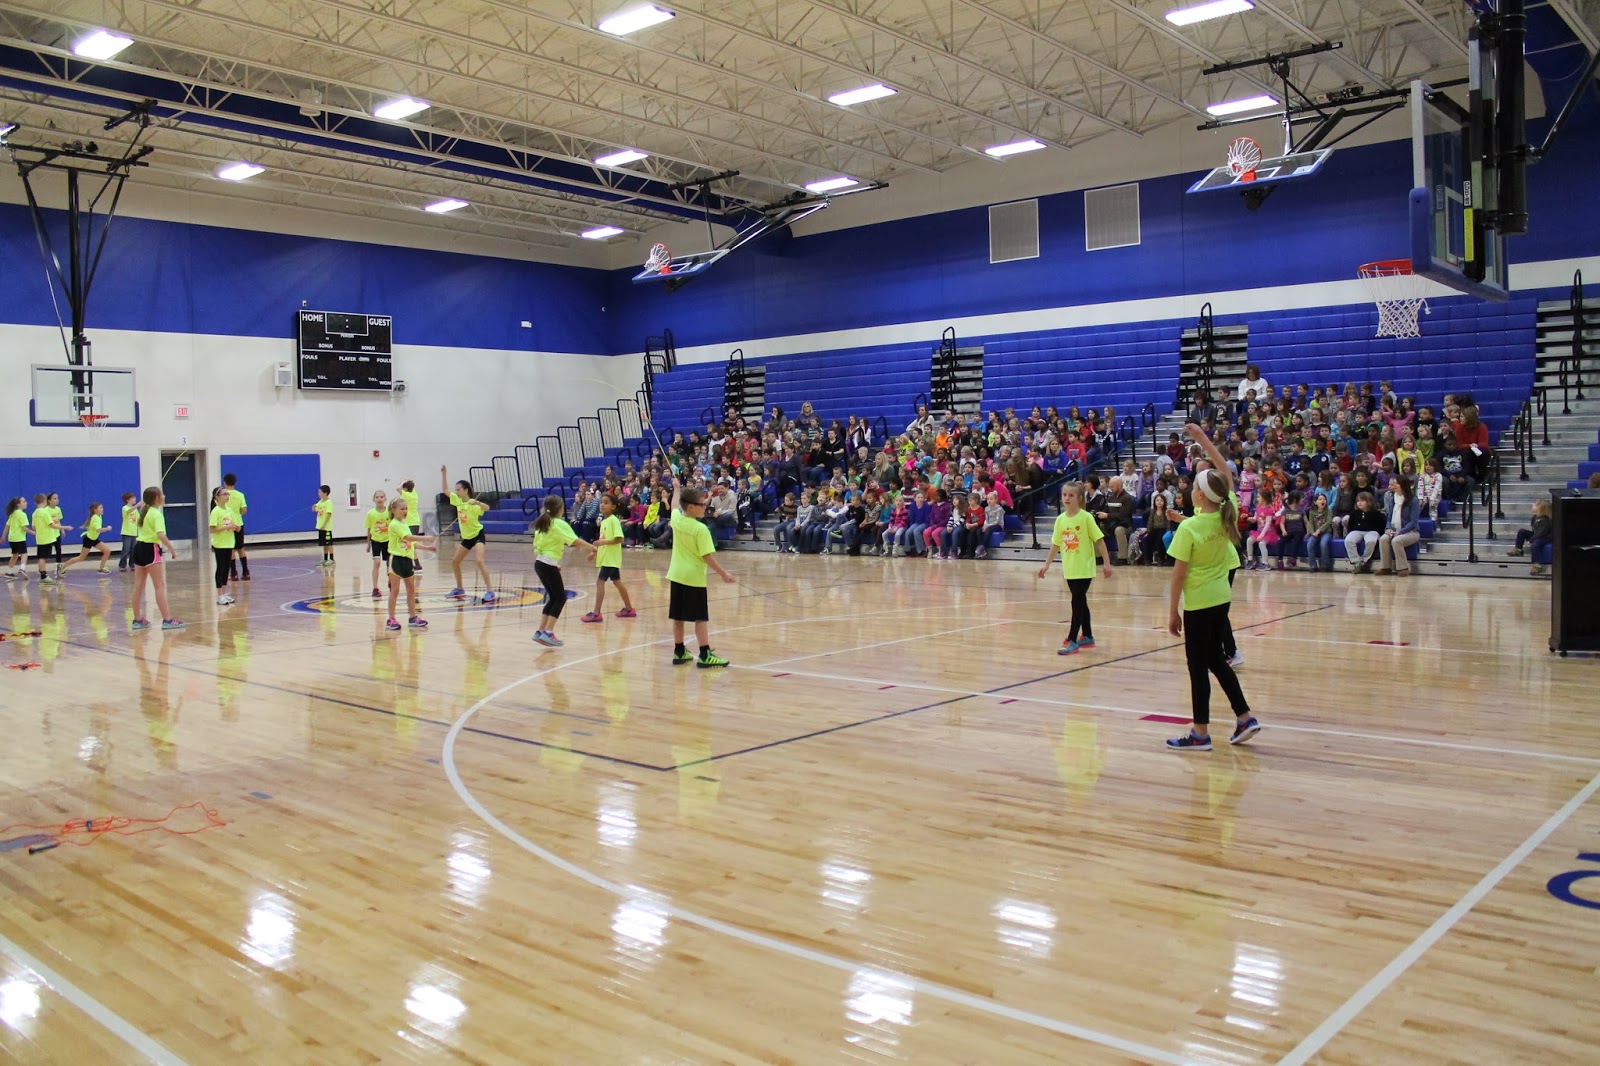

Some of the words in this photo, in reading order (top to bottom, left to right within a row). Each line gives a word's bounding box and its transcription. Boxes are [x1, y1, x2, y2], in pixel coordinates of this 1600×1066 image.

[302, 314, 324, 322] HOME
[369, 318, 390, 326] GUEST
[178, 407, 188, 415] EXIT
[182, 437, 186, 445] 3
